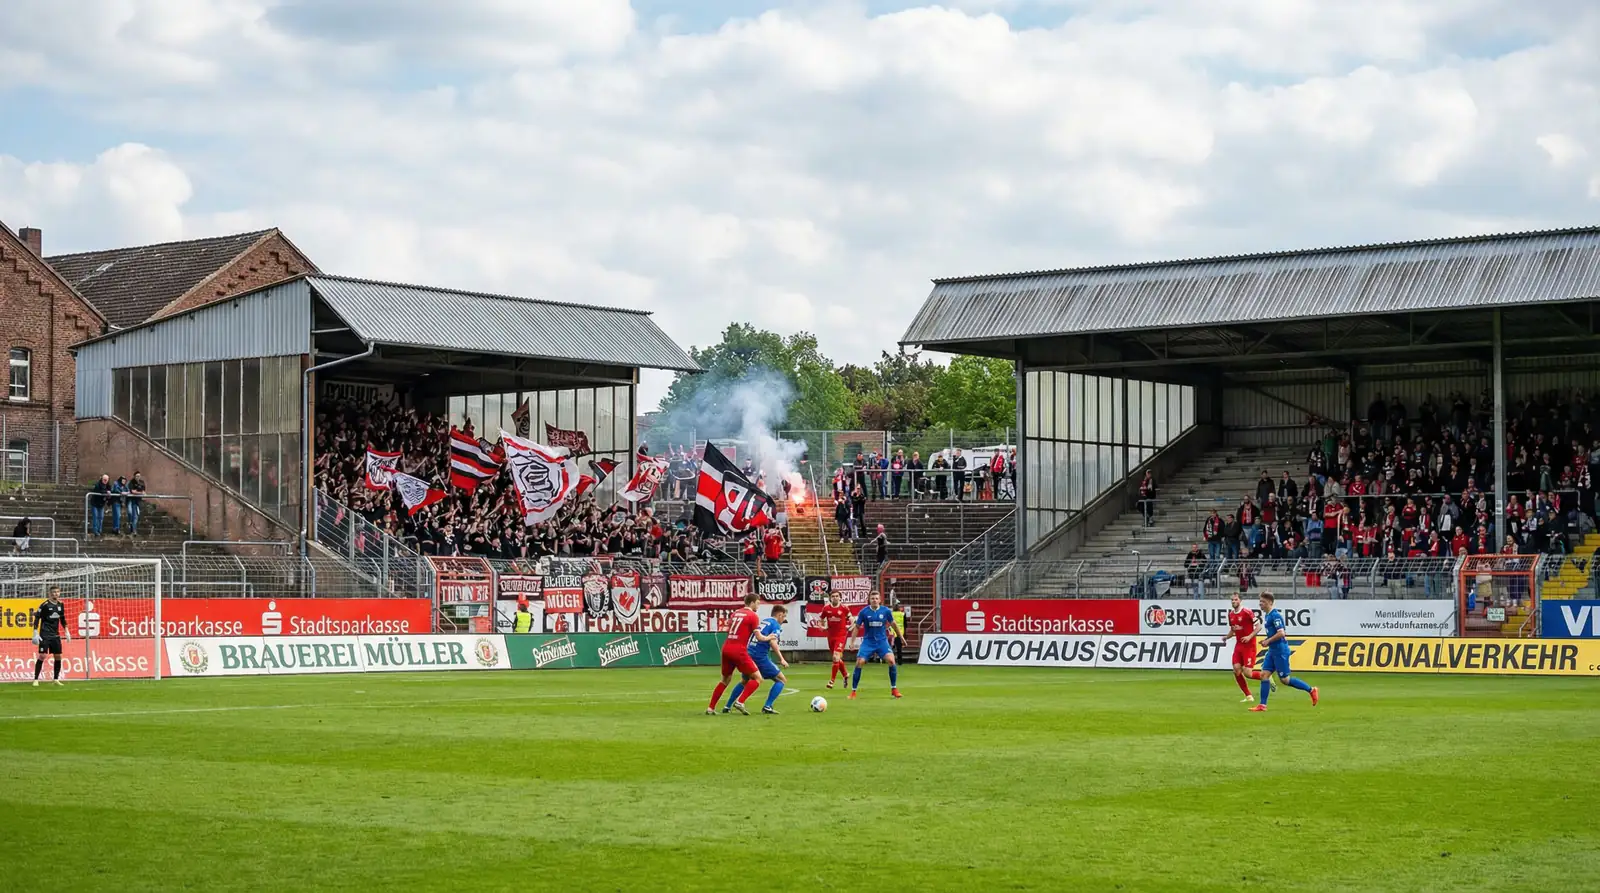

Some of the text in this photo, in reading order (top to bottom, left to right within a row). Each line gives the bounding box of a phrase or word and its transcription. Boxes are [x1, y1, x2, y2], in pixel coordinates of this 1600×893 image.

[109, 616, 243, 637] Stadtsparkasse
[290, 614, 410, 635] Stadtsparkasse
[992, 614, 1114, 634] Stadtsparkasse
[219, 637, 468, 669] BRAUEREI MÜLLER
[957, 640, 1096, 662] AUTOHAUS
[1102, 641, 1227, 663] SCHMIDT
[1312, 641, 1579, 670] REGIONALVERKEHR
